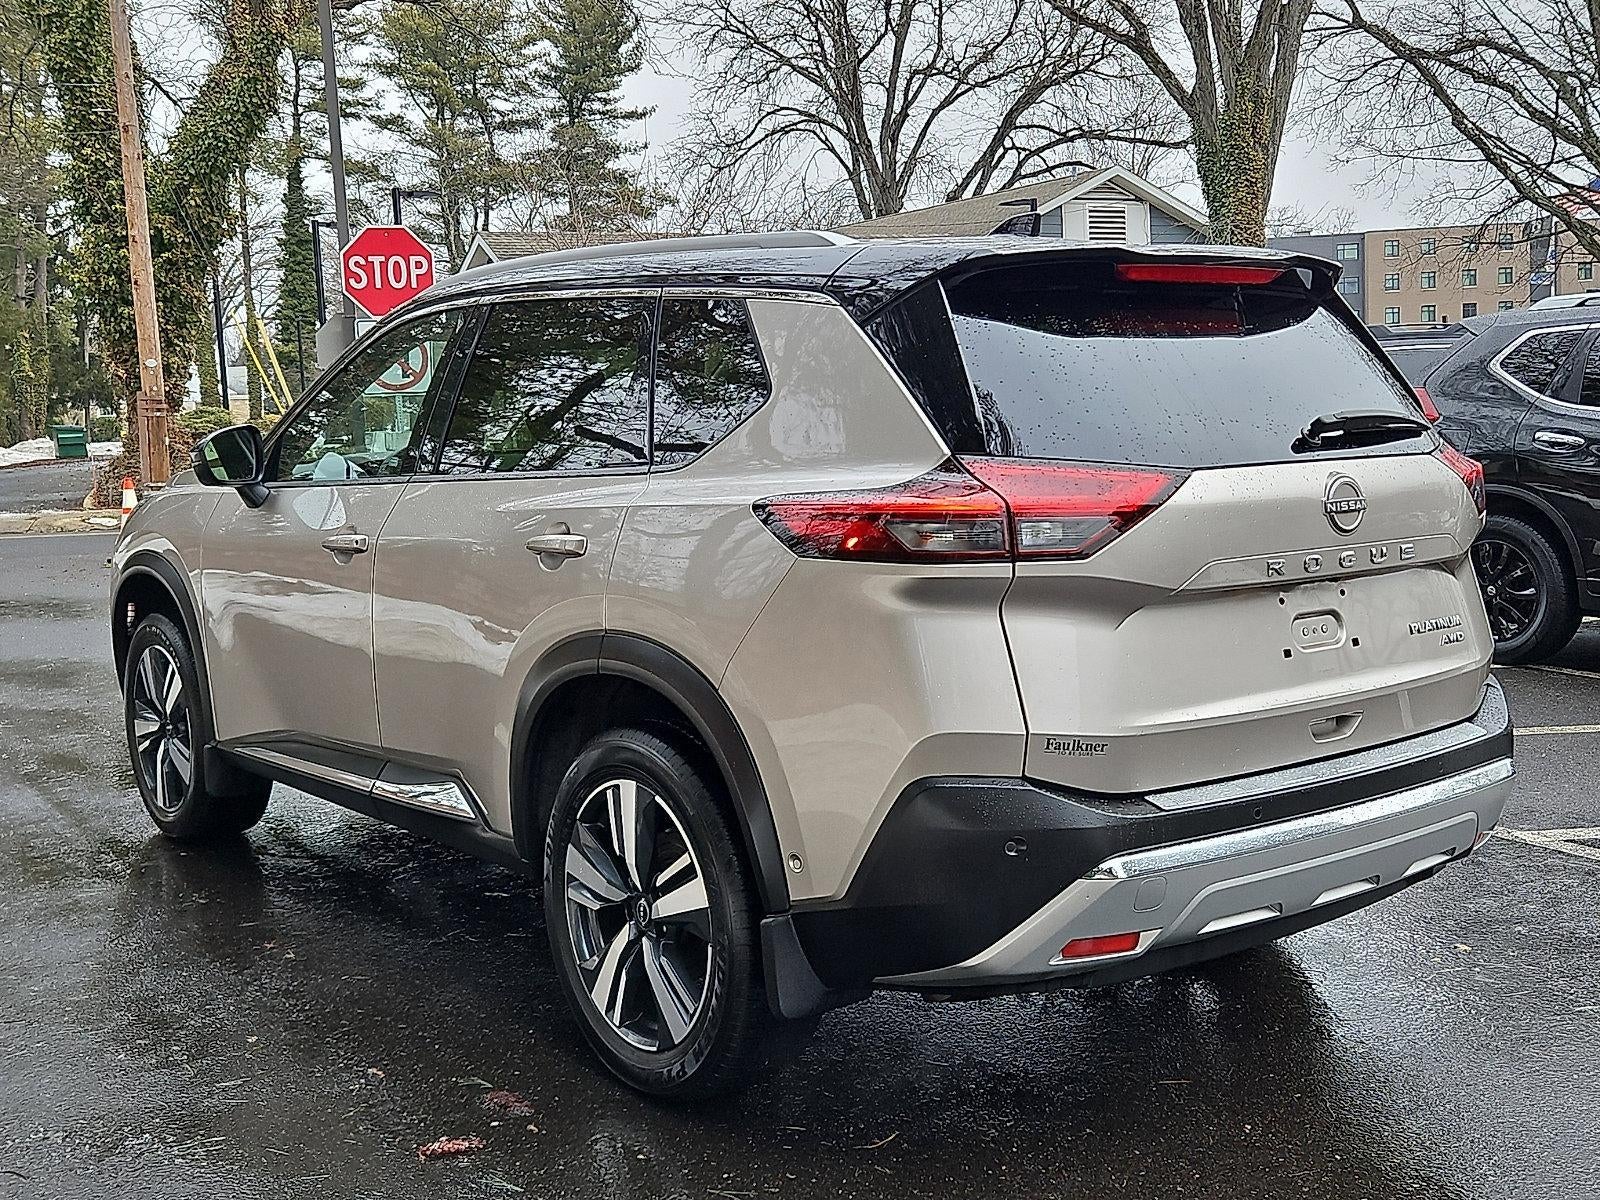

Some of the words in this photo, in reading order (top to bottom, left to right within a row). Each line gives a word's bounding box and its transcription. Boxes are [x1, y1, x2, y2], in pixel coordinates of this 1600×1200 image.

[348, 255, 429, 289] STOP
[1326, 500, 1367, 512] NISSAN
[1266, 543, 1416, 577] ROGUE
[1408, 614, 1462, 635] PLATINUM
[1440, 631, 1465, 646] AWD
[1044, 737, 1108, 752] Faulkner
